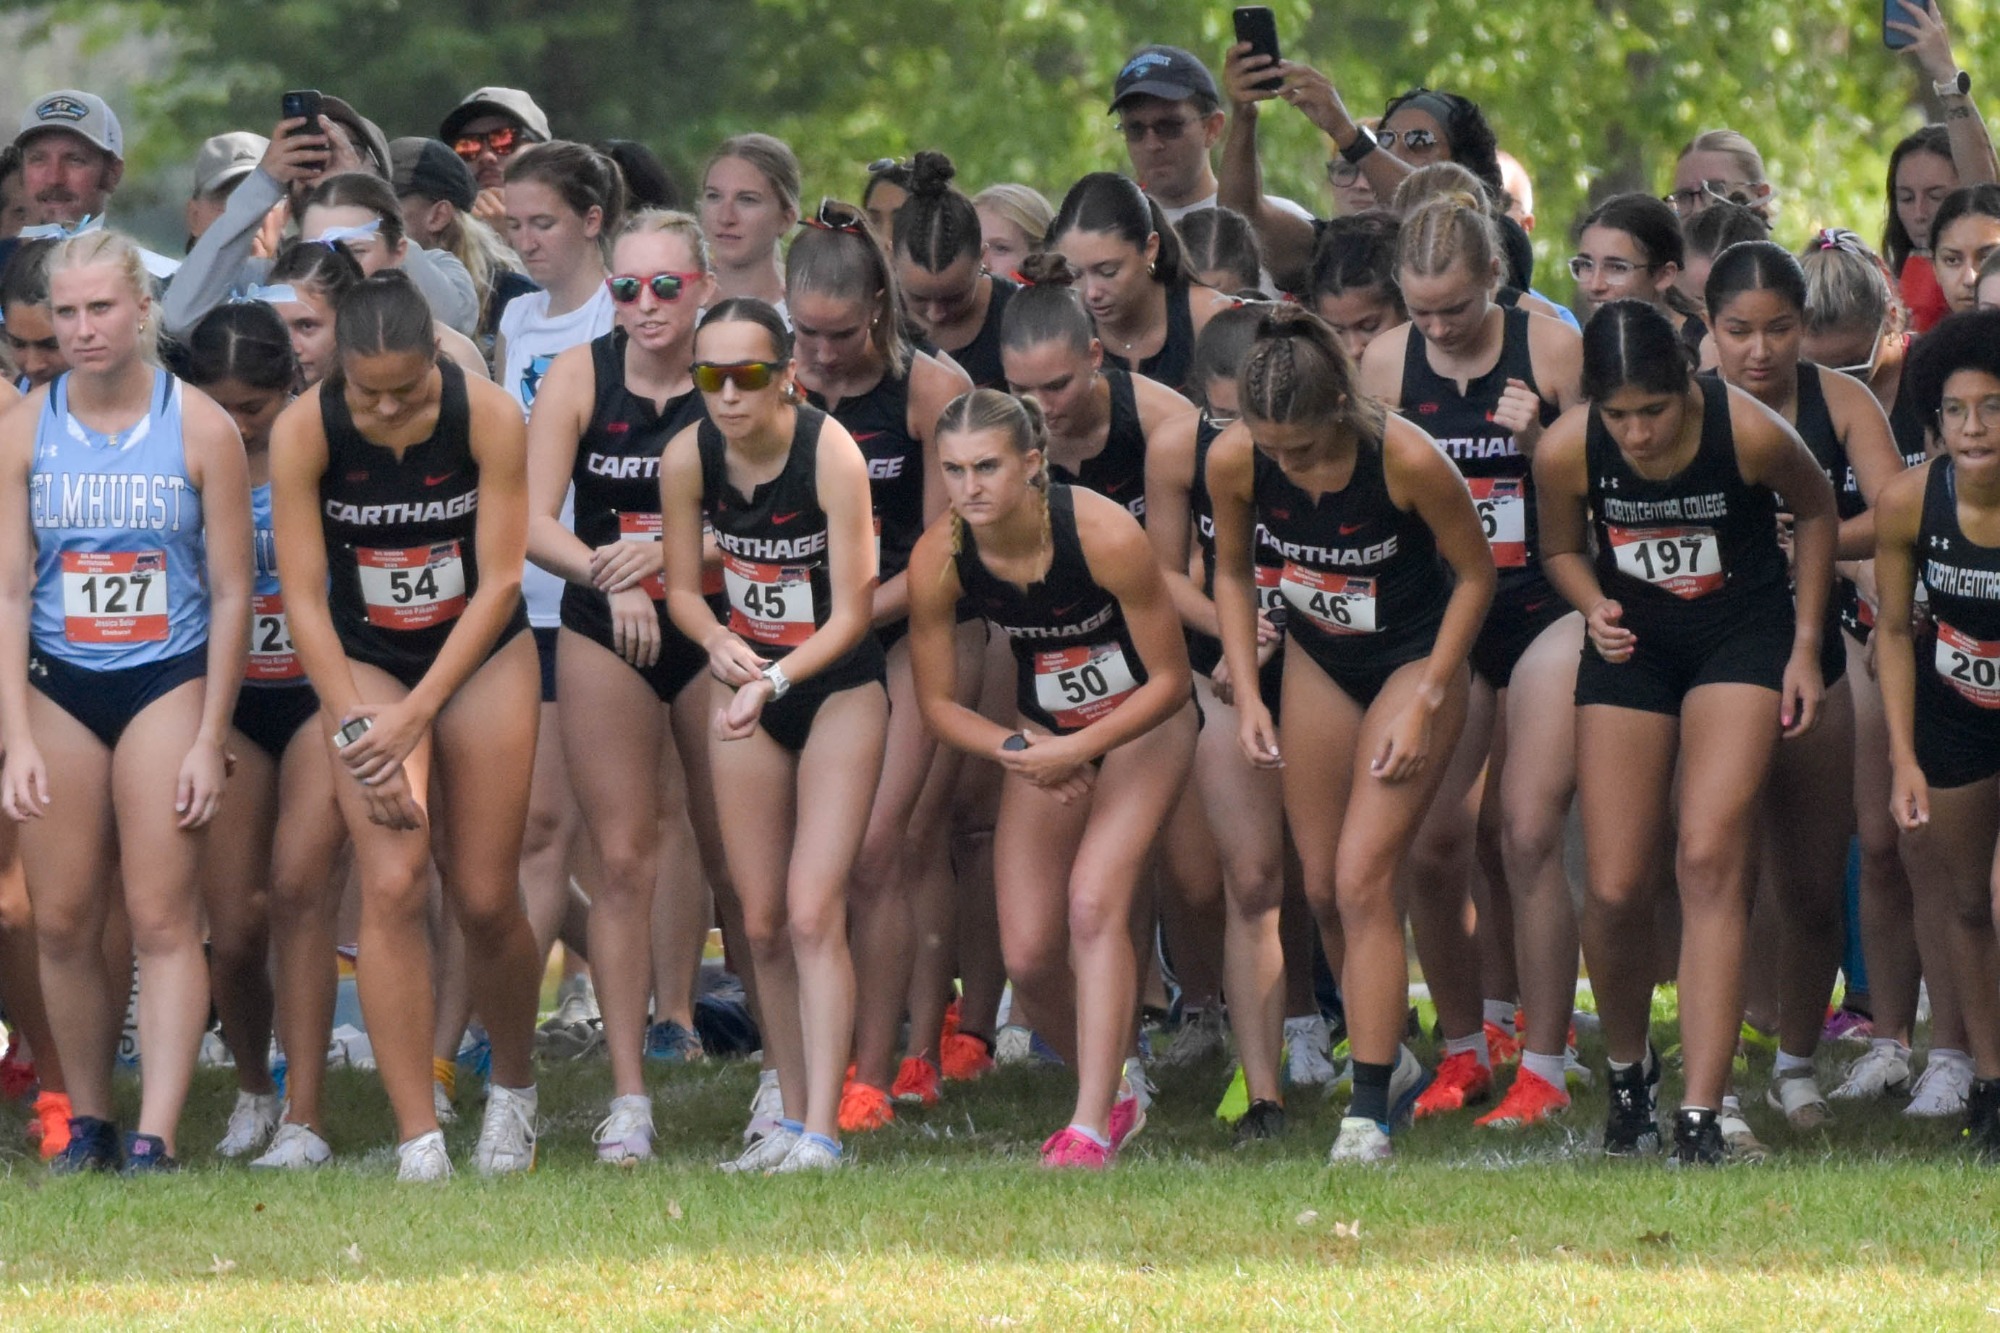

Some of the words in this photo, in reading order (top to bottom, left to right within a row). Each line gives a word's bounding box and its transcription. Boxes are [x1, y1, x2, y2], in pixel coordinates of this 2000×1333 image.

[588, 453, 661, 479] CART
[31, 473, 184, 531] ELMHURST
[326, 488, 477, 525] CARTHAGE
[1605, 498, 1637, 522] NORTH
[1638, 499, 1683, 520] CENTRAL
[1684, 493, 1727, 519] COLLEGE
[714, 530, 827, 559] ARTHAGE
[1270, 535, 1398, 566] ARTHAGE
[1634, 540, 1703, 579] 197
[82, 576, 152, 613] 127
[391, 568, 439, 604] 54
[1926, 559, 1958, 595] NORTH
[744, 583, 786, 619] 45
[1309, 592, 1351, 625] 46
[1004, 602, 1113, 638] RTHAGE
[1058, 664, 1109, 704] 50
[1951, 651, 2000, 688] 20
